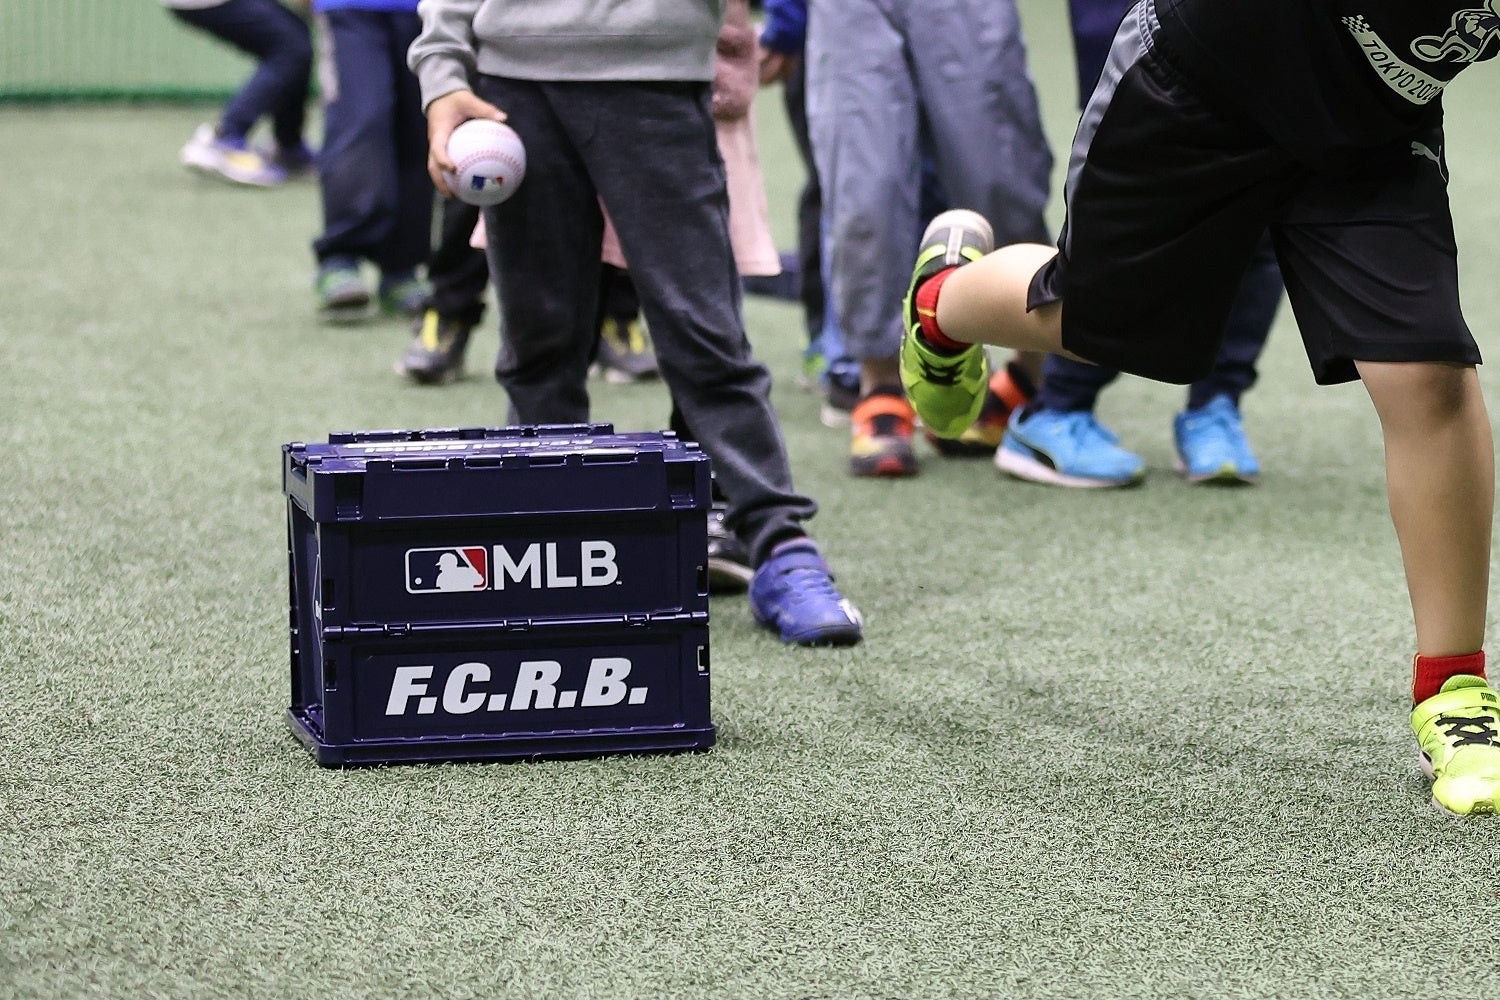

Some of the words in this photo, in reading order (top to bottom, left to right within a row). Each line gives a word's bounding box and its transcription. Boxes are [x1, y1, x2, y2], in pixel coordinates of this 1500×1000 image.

[1363, 39, 1416, 89] TOKYO
[492, 540, 620, 591] MLB
[384, 657, 649, 716] F.C.R.B.
